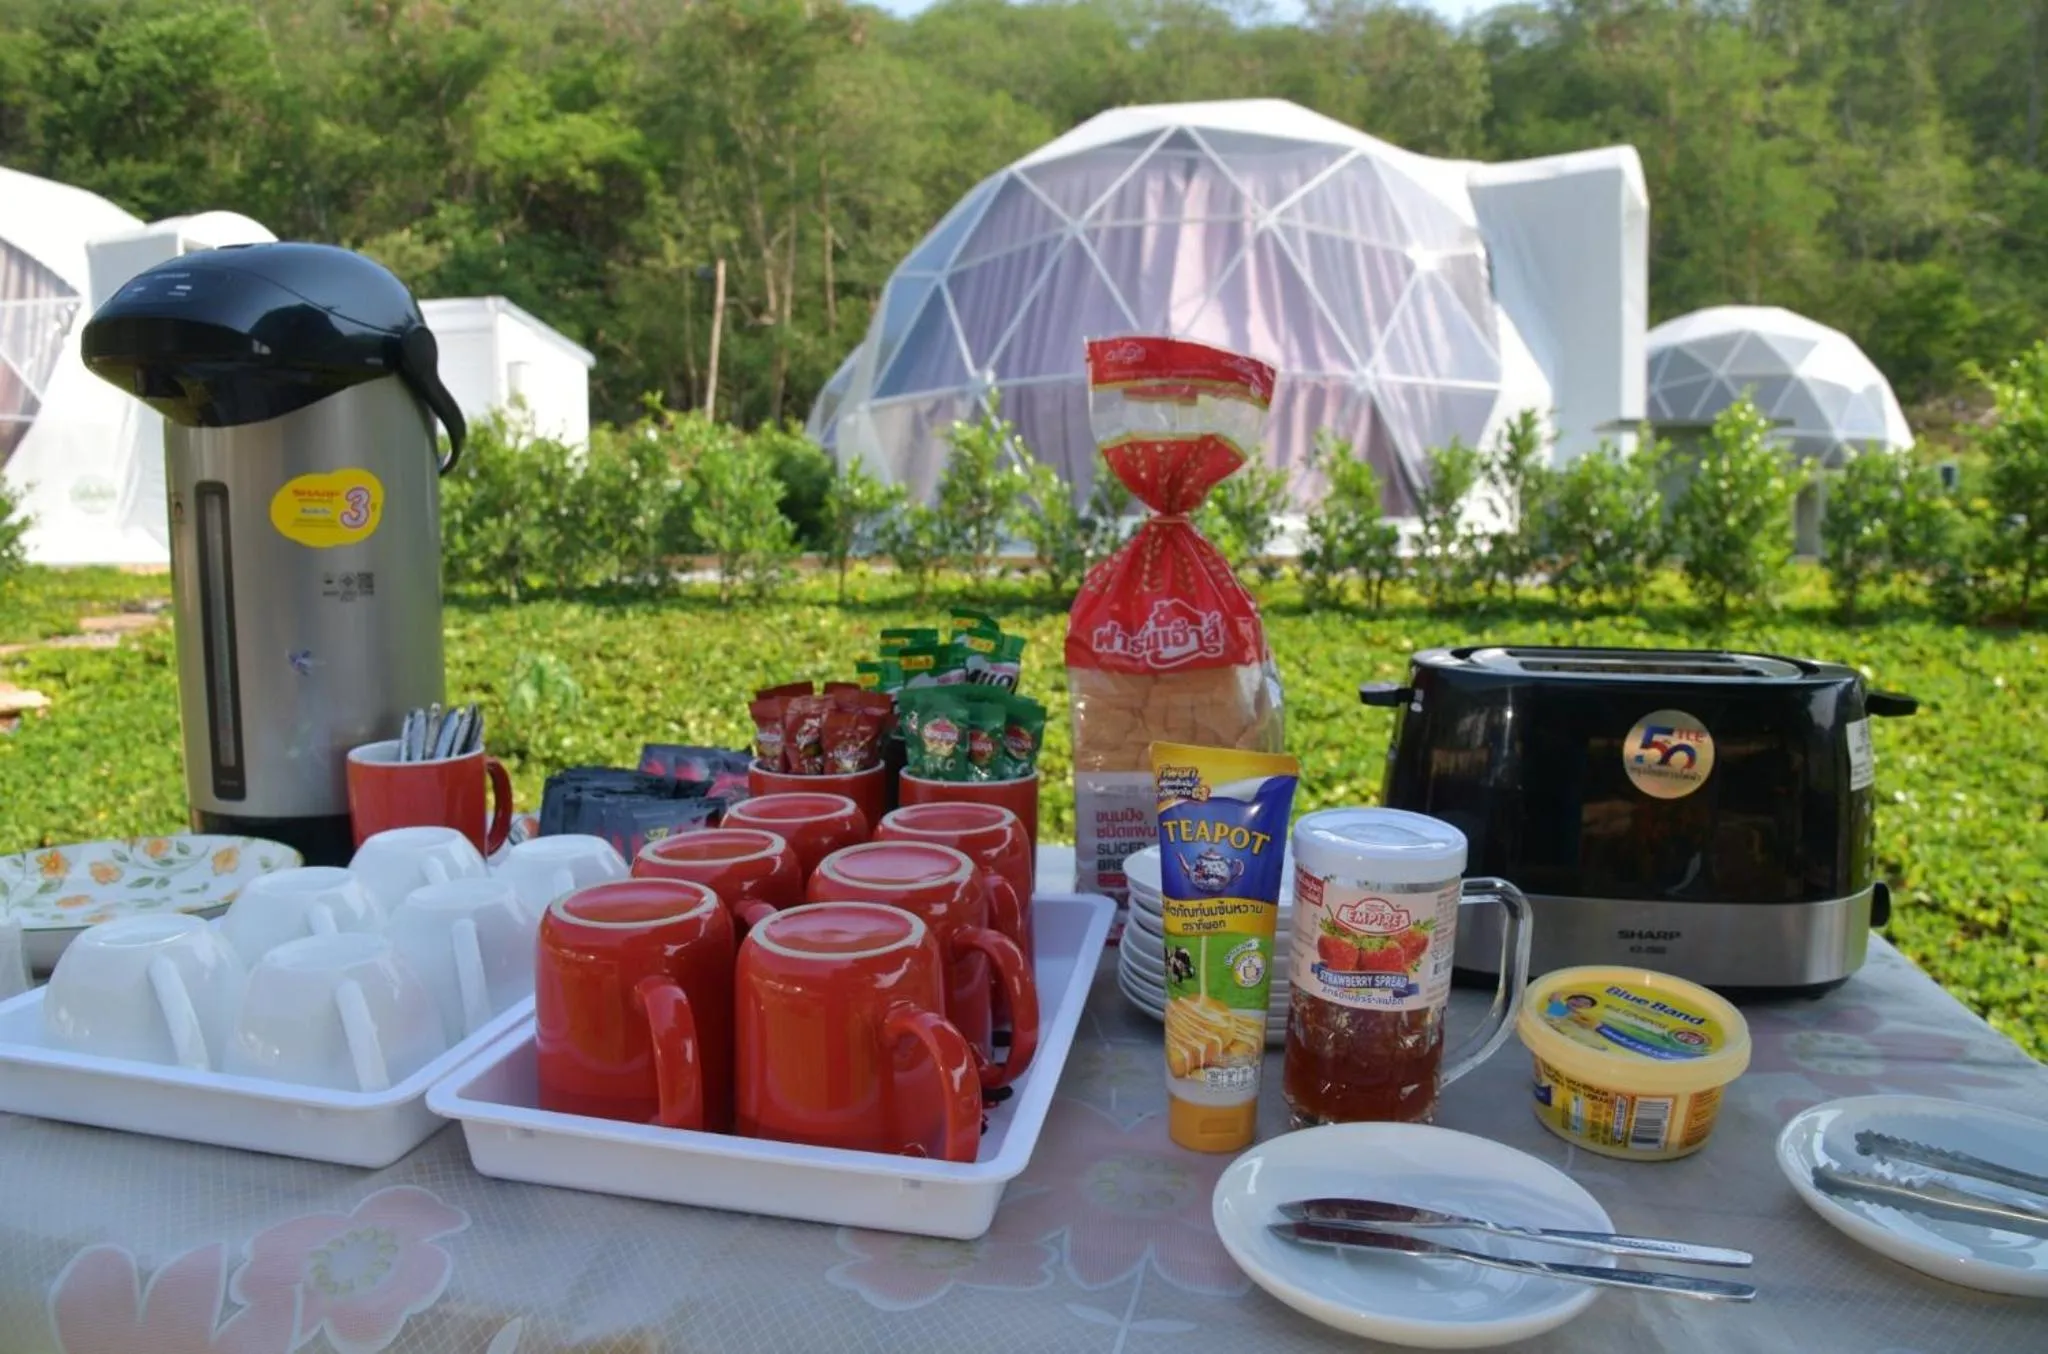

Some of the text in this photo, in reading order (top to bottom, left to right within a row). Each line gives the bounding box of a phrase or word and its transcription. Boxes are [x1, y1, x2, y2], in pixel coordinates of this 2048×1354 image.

[339, 486, 370, 528] 3
[1096, 808, 1144, 823] ขนมปัง
[1162, 820, 1271, 855] TEAPOT
[1097, 859, 1124, 871] BRE
[1348, 908, 1402, 928] EMPIRE
[1617, 929, 1682, 941] SHARP
[1320, 970, 1408, 988] STRAWBERRY SPREAD
[1605, 985, 1705, 1025] Blue Band
